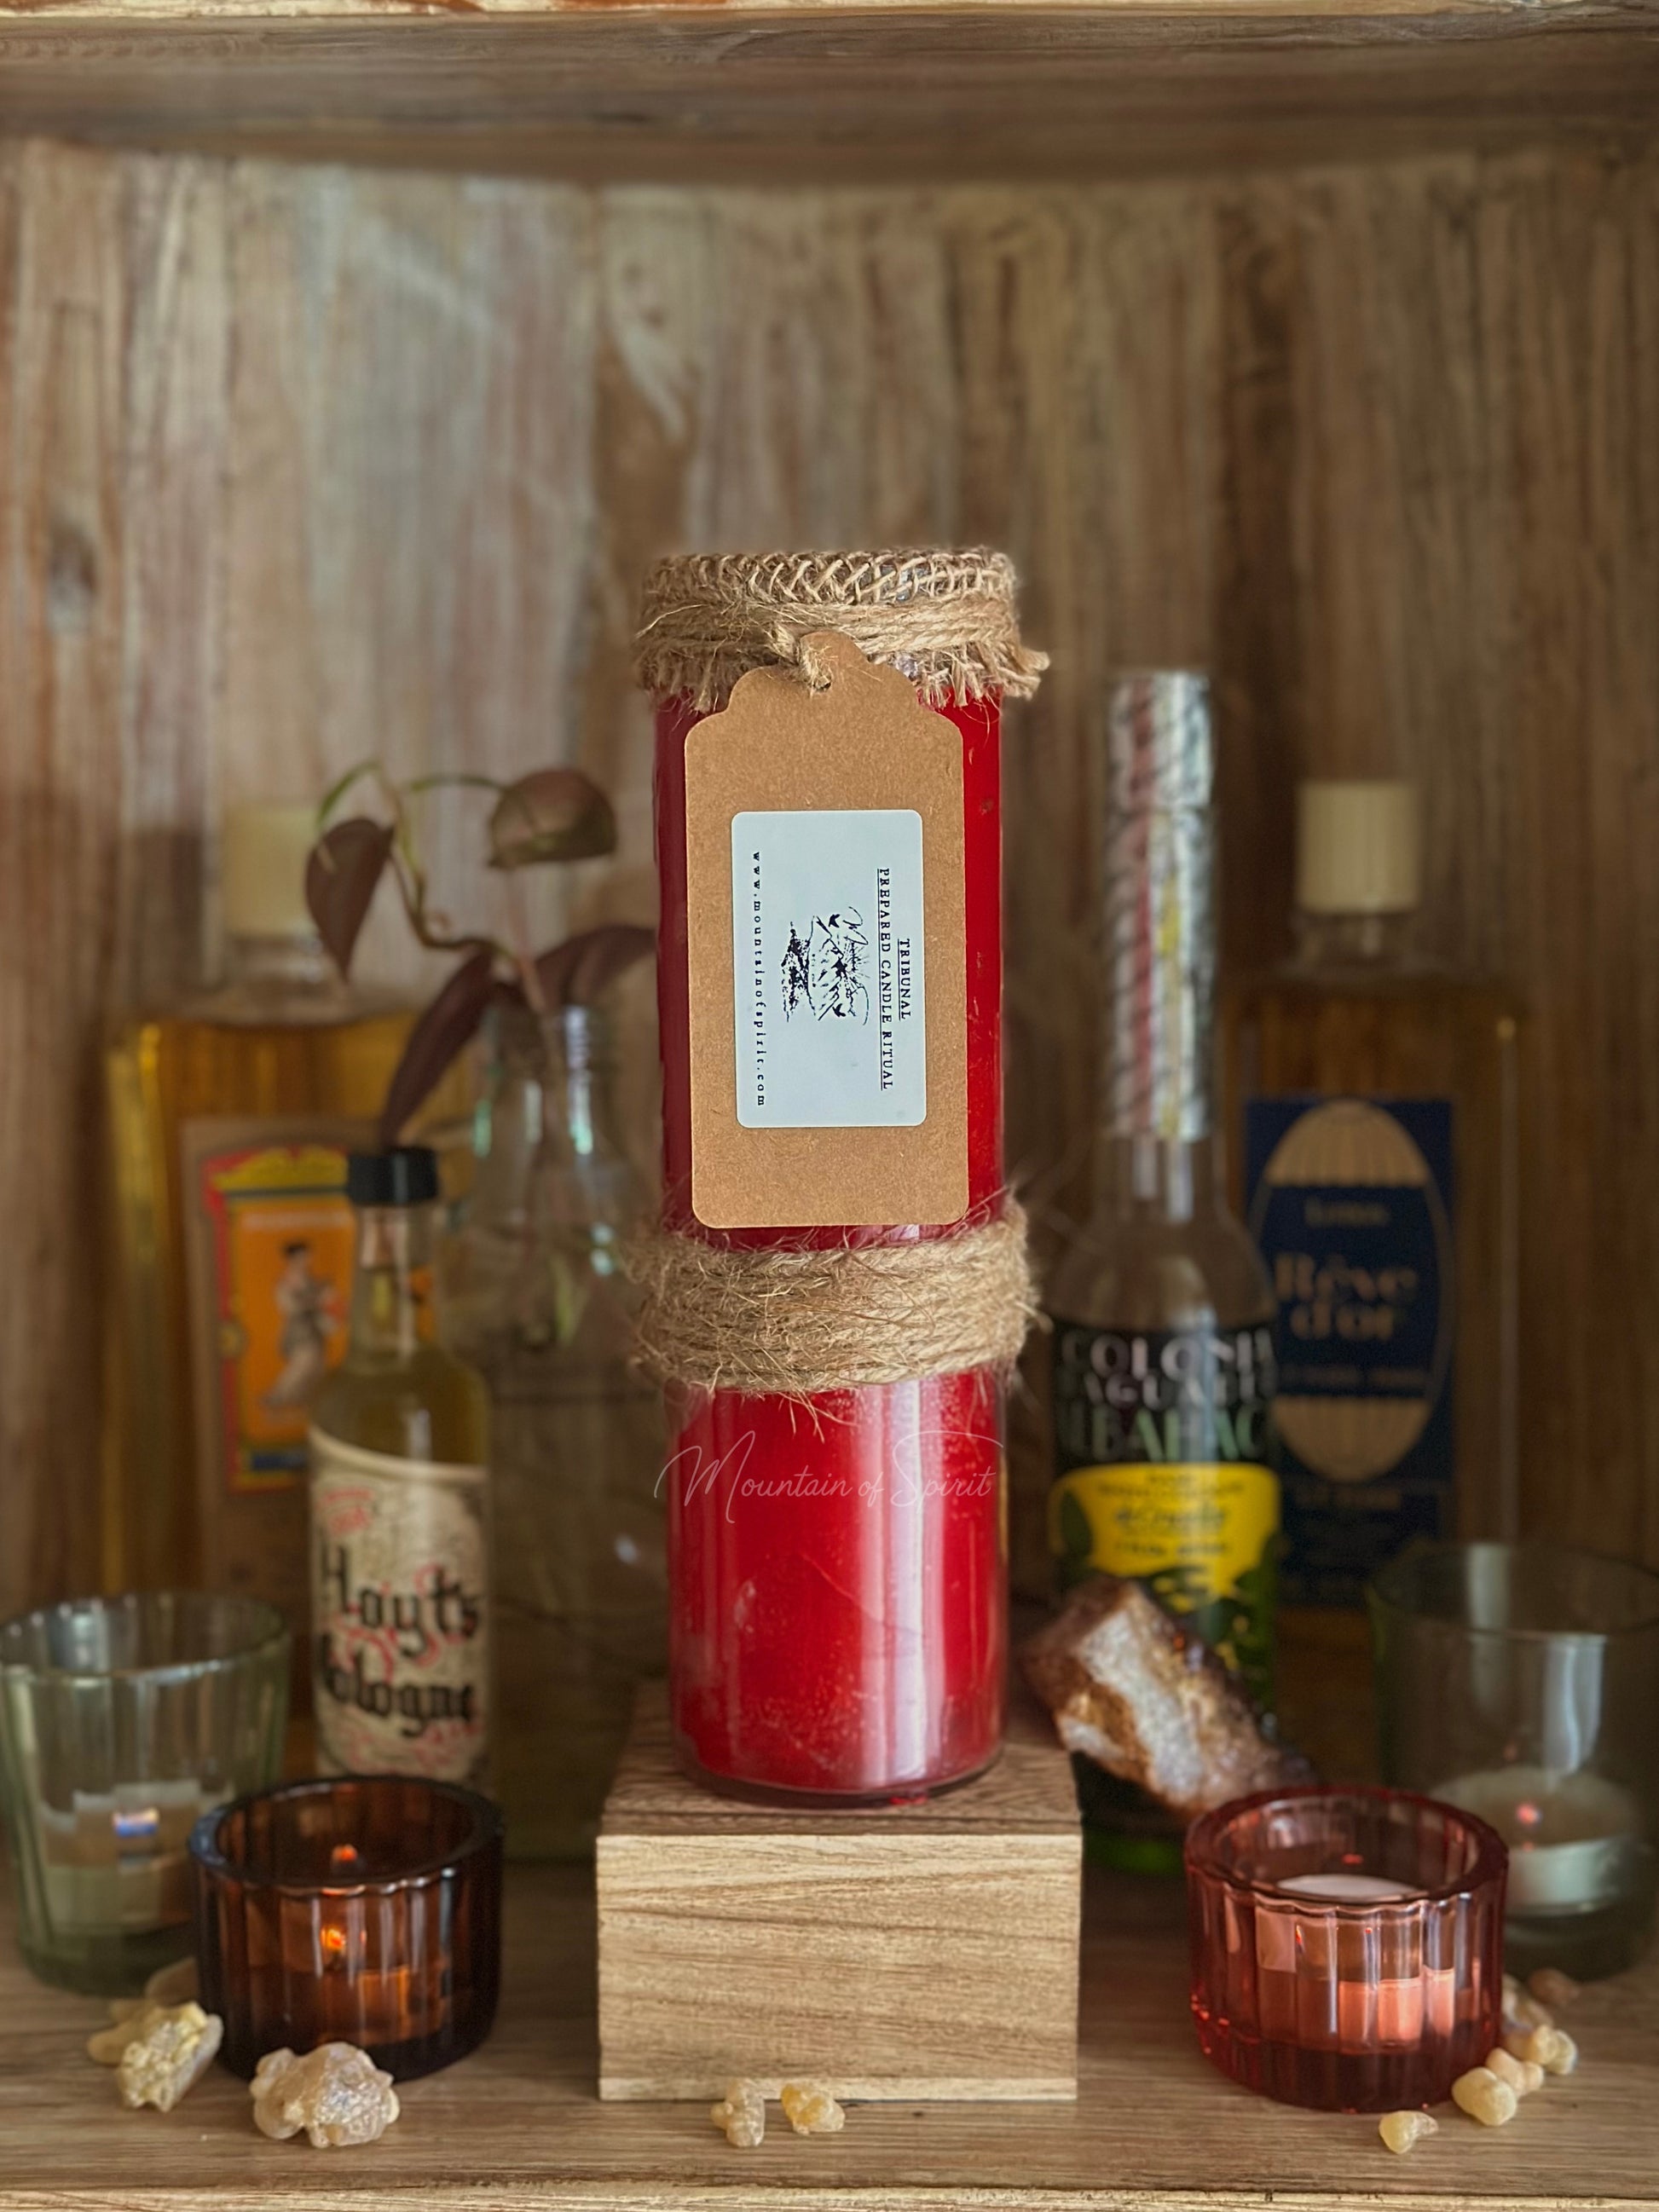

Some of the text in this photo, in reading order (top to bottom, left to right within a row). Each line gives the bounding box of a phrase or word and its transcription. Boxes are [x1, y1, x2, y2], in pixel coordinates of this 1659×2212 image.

[753, 851, 767, 1106] www.mountainofspirit.com
[877, 868, 893, 1090] PREPARED CANDLE RITUAL
[899, 939, 911, 1020] TRIBUNAL
